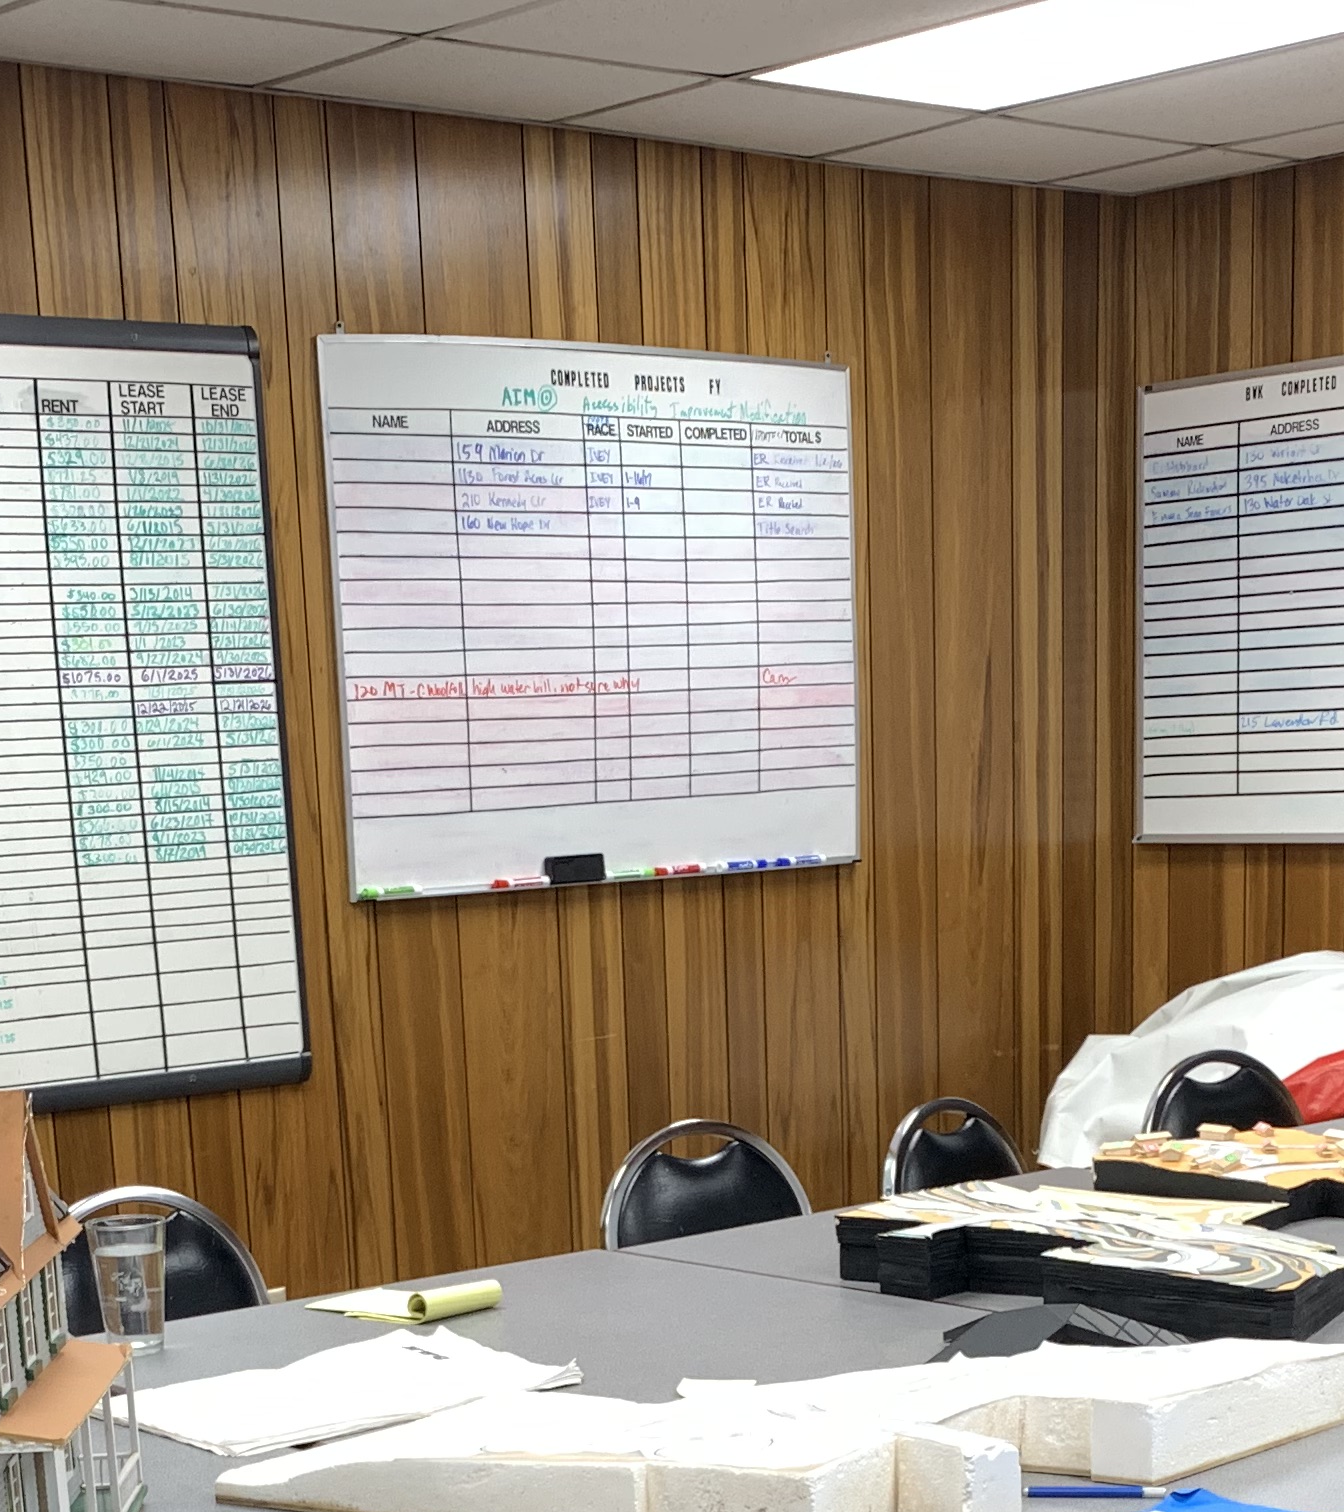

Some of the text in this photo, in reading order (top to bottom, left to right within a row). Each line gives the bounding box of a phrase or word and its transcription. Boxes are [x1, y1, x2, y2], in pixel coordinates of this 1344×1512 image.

[551, 369, 721, 395] COMPLETED PROJECTS FY
[1245, 385, 1264, 401] BWK
[1281, 375, 1338, 396] COMPLETED
[119, 384, 165, 399] LEASE
[201, 387, 246, 401] LEASE
[502, 387, 536, 407] AIM
[41, 399, 78, 413] RENT
[121, 401, 165, 415] START
[211, 404, 239, 417] END
[372, 415, 409, 429] NAME
[487, 420, 540, 433] ADDRESS
[1270, 419, 1320, 435] ADDRESS
[586, 423, 615, 436] RACE
[627, 425, 673, 439] STARTED
[685, 427, 747, 441] COMPLETED
[1176, 434, 1205, 448] NAME
[62, 670, 121, 683] $1075.00
